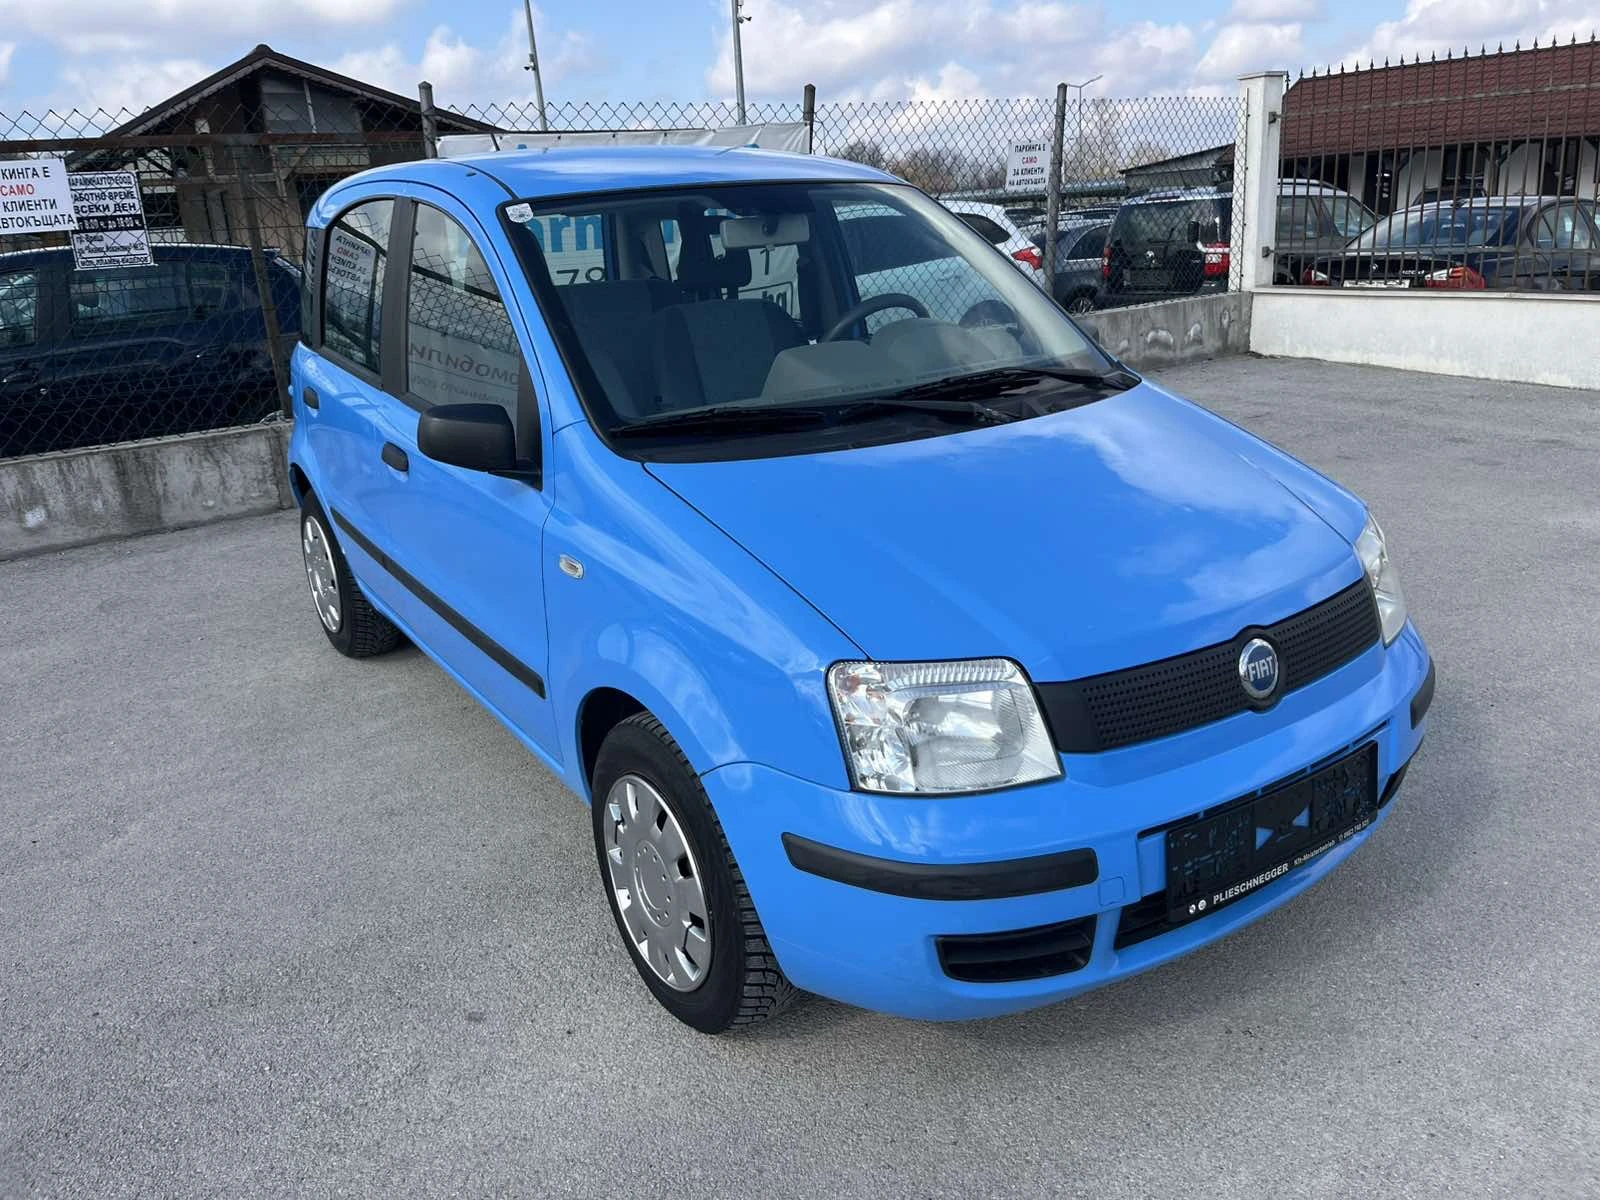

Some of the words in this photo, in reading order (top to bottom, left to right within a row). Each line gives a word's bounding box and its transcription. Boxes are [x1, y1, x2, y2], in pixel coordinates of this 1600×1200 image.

[42, 166, 51, 178] Е
[0, 183, 35, 196] САМО
[2, 198, 58, 213] КЛИЕНТИ
[74, 204, 110, 214] ВСЕКИ
[114, 202, 136, 213] ДЕН
[0, 213, 76, 229] ВТОКЪЩАТА
[1248, 655, 1274, 682] FIAT
[1213, 862, 1289, 904] PLIESCHNEGGER
